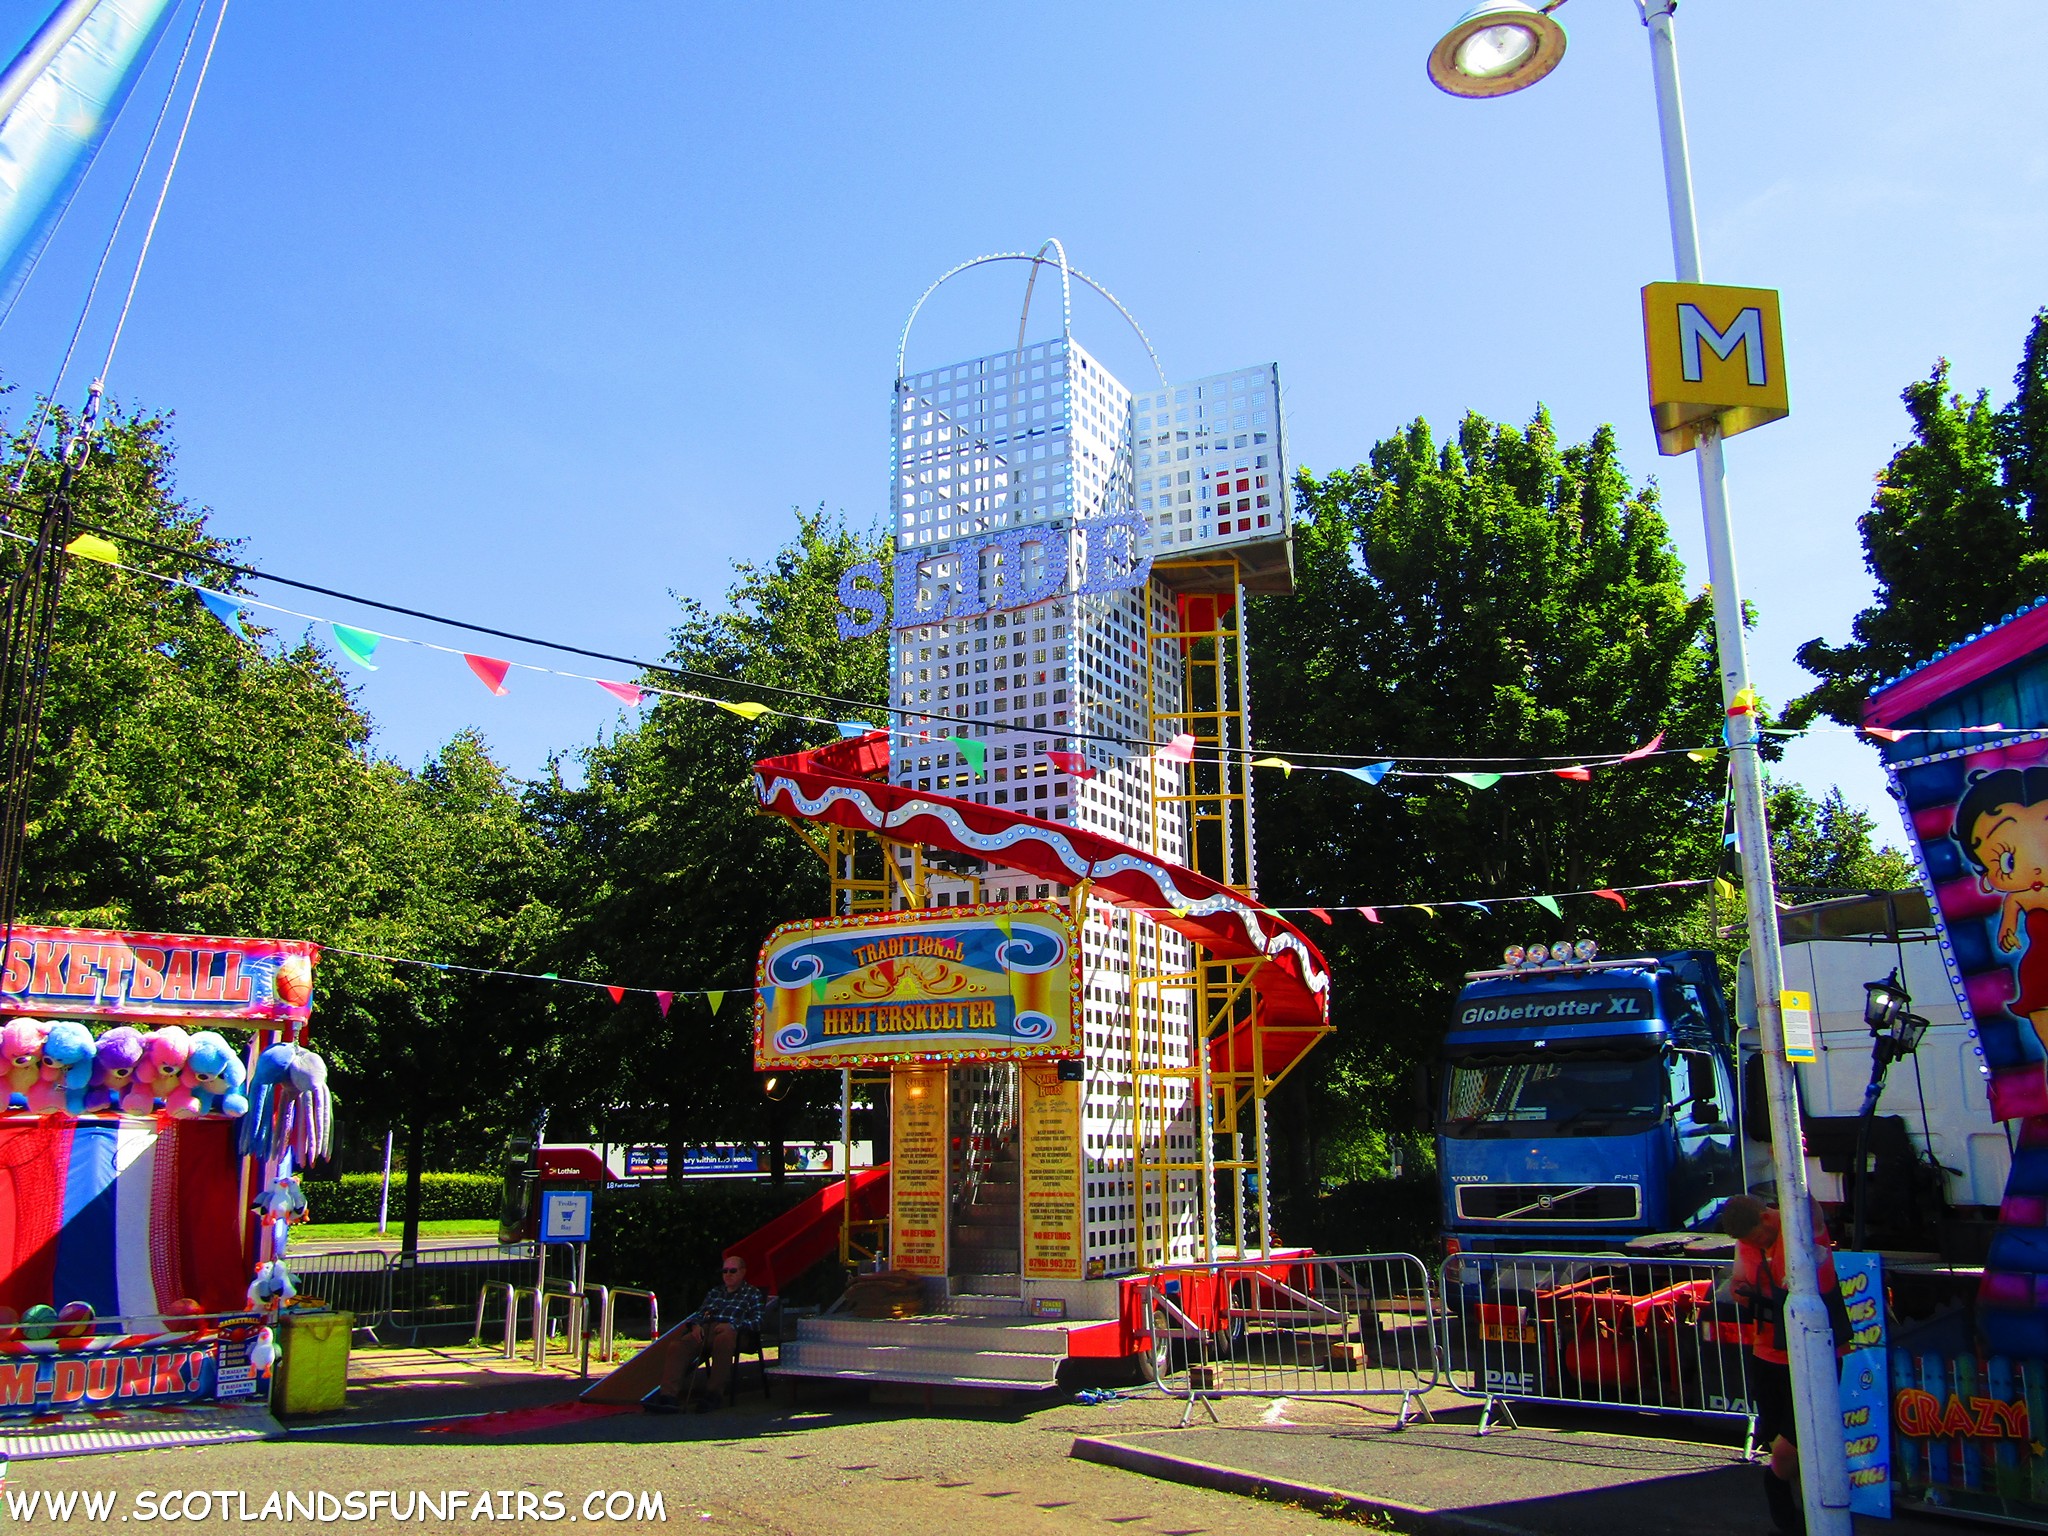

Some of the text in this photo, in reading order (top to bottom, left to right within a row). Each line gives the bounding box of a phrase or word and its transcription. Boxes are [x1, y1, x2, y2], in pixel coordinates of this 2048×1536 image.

[1676, 303, 1767, 387] M
[836, 509, 1154, 642] SLIDE
[852, 935, 965, 968] TRADITIONAL
[0, 938, 252, 1002] SKETBALL
[822, 1000, 998, 1036] HELTERSKELTER
[1461, 998, 1640, 1025] Globetrotter XL
[1043, 1232, 1071, 1240] REFUNDS
[1839, 1272, 1867, 1297] WO
[1487, 1370, 1534, 1384] DAF
[1843, 1406, 1870, 1428] THE
[1896, 1388, 2028, 1438] CRAZY
[1845, 1436, 1879, 1457] RAZY
